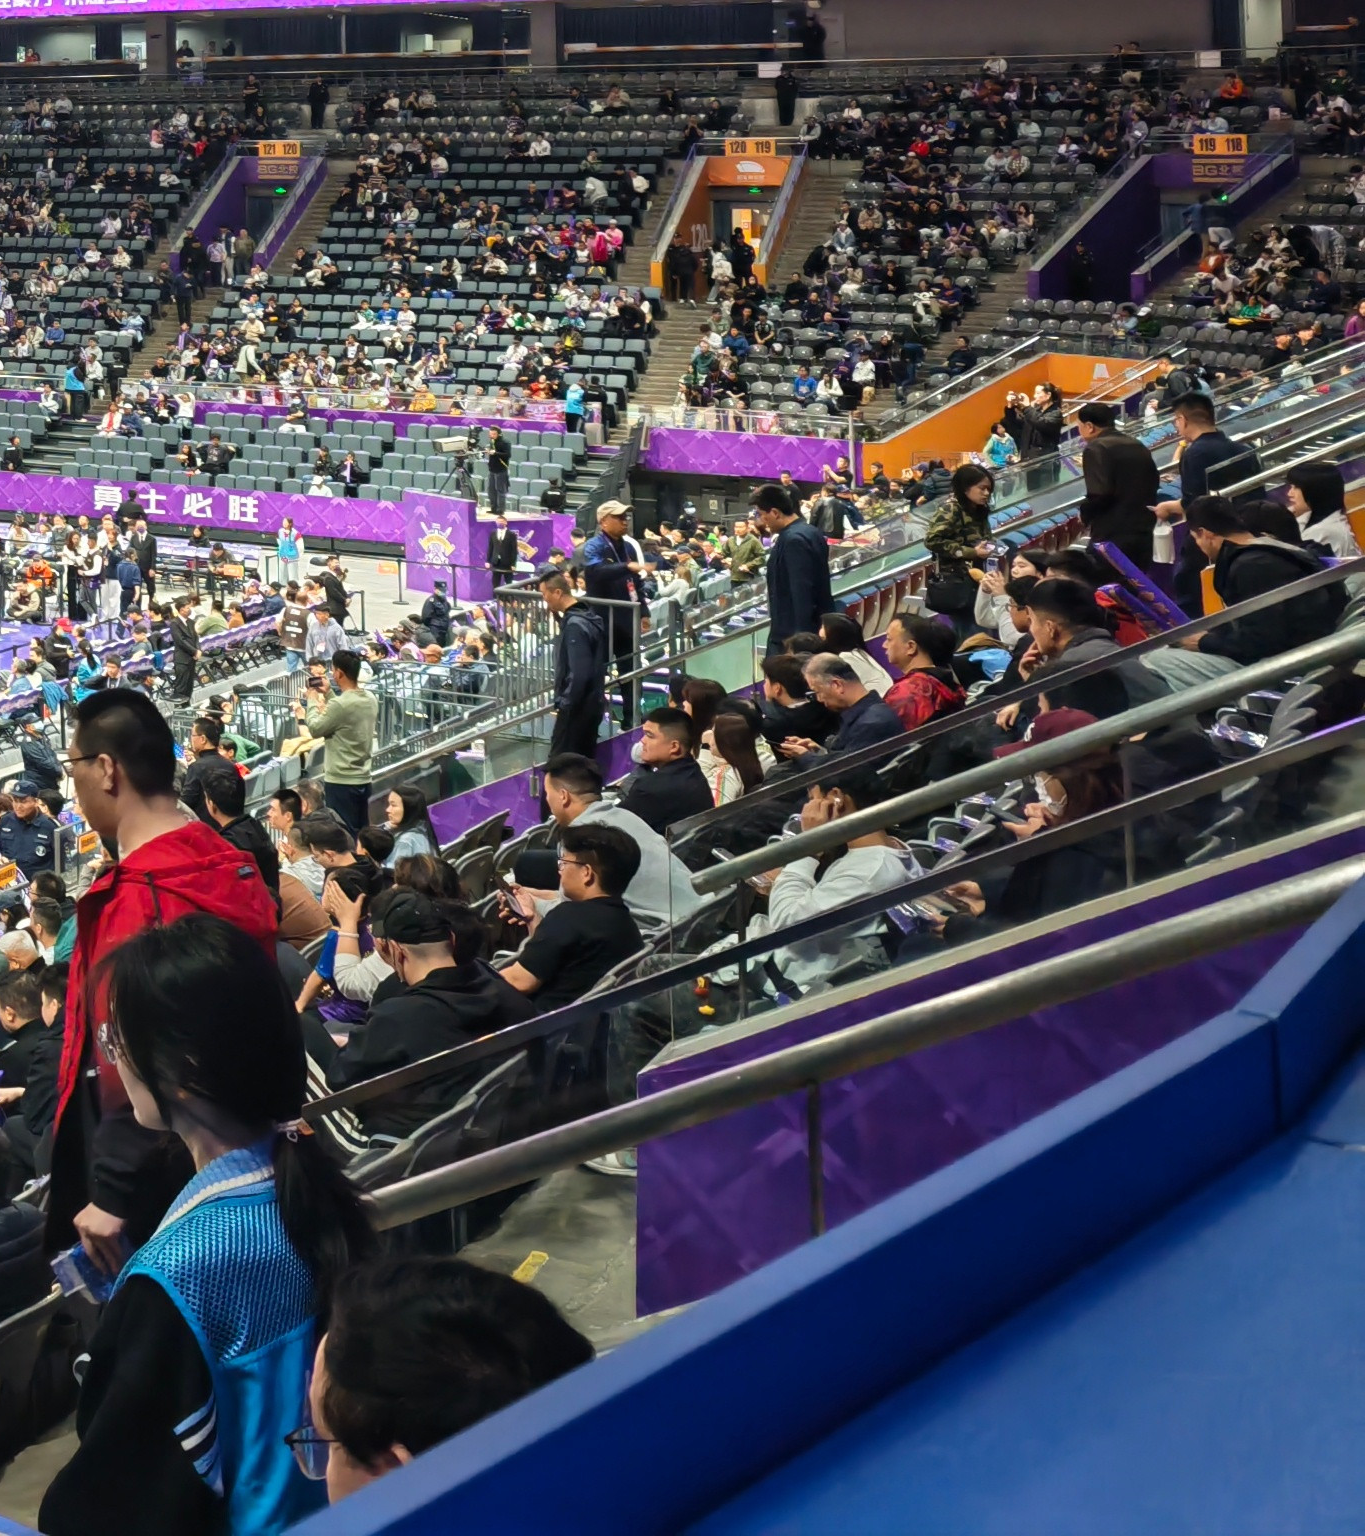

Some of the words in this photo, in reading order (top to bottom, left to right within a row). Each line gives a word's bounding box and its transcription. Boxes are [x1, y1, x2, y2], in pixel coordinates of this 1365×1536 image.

[265, 144, 277, 155] 121
[283, 144, 298, 155] 120
[729, 139, 747, 154] 120
[754, 139, 771, 153] 119
[1198, 137, 1216, 152] 119
[1224, 136, 1242, 152] 118
[93, 484, 260, 522] 勇士必胜
